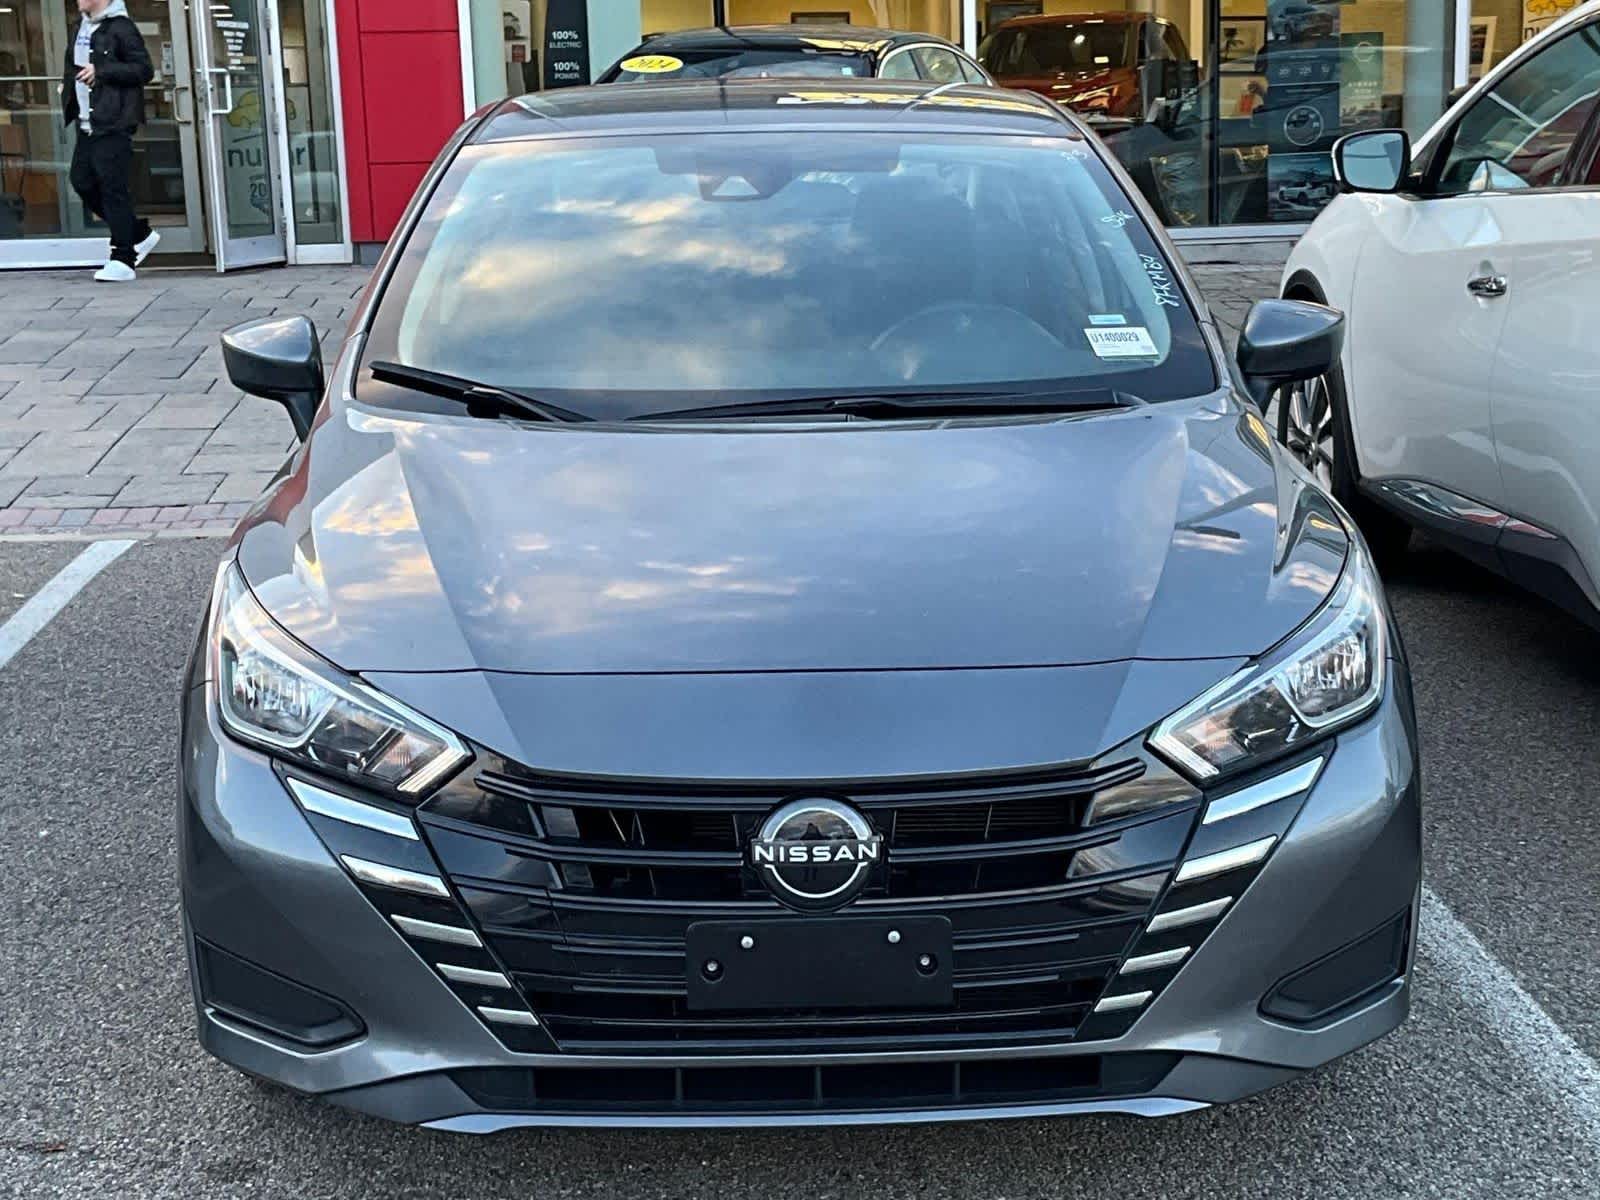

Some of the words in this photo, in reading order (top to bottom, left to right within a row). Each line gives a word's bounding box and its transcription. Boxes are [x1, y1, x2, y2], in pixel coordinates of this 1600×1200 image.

[551, 31, 579, 40] 100%
[549, 41, 582, 49] ELECTRIC
[553, 62, 580, 71] 100%
[754, 842, 878, 863] NISSAN
